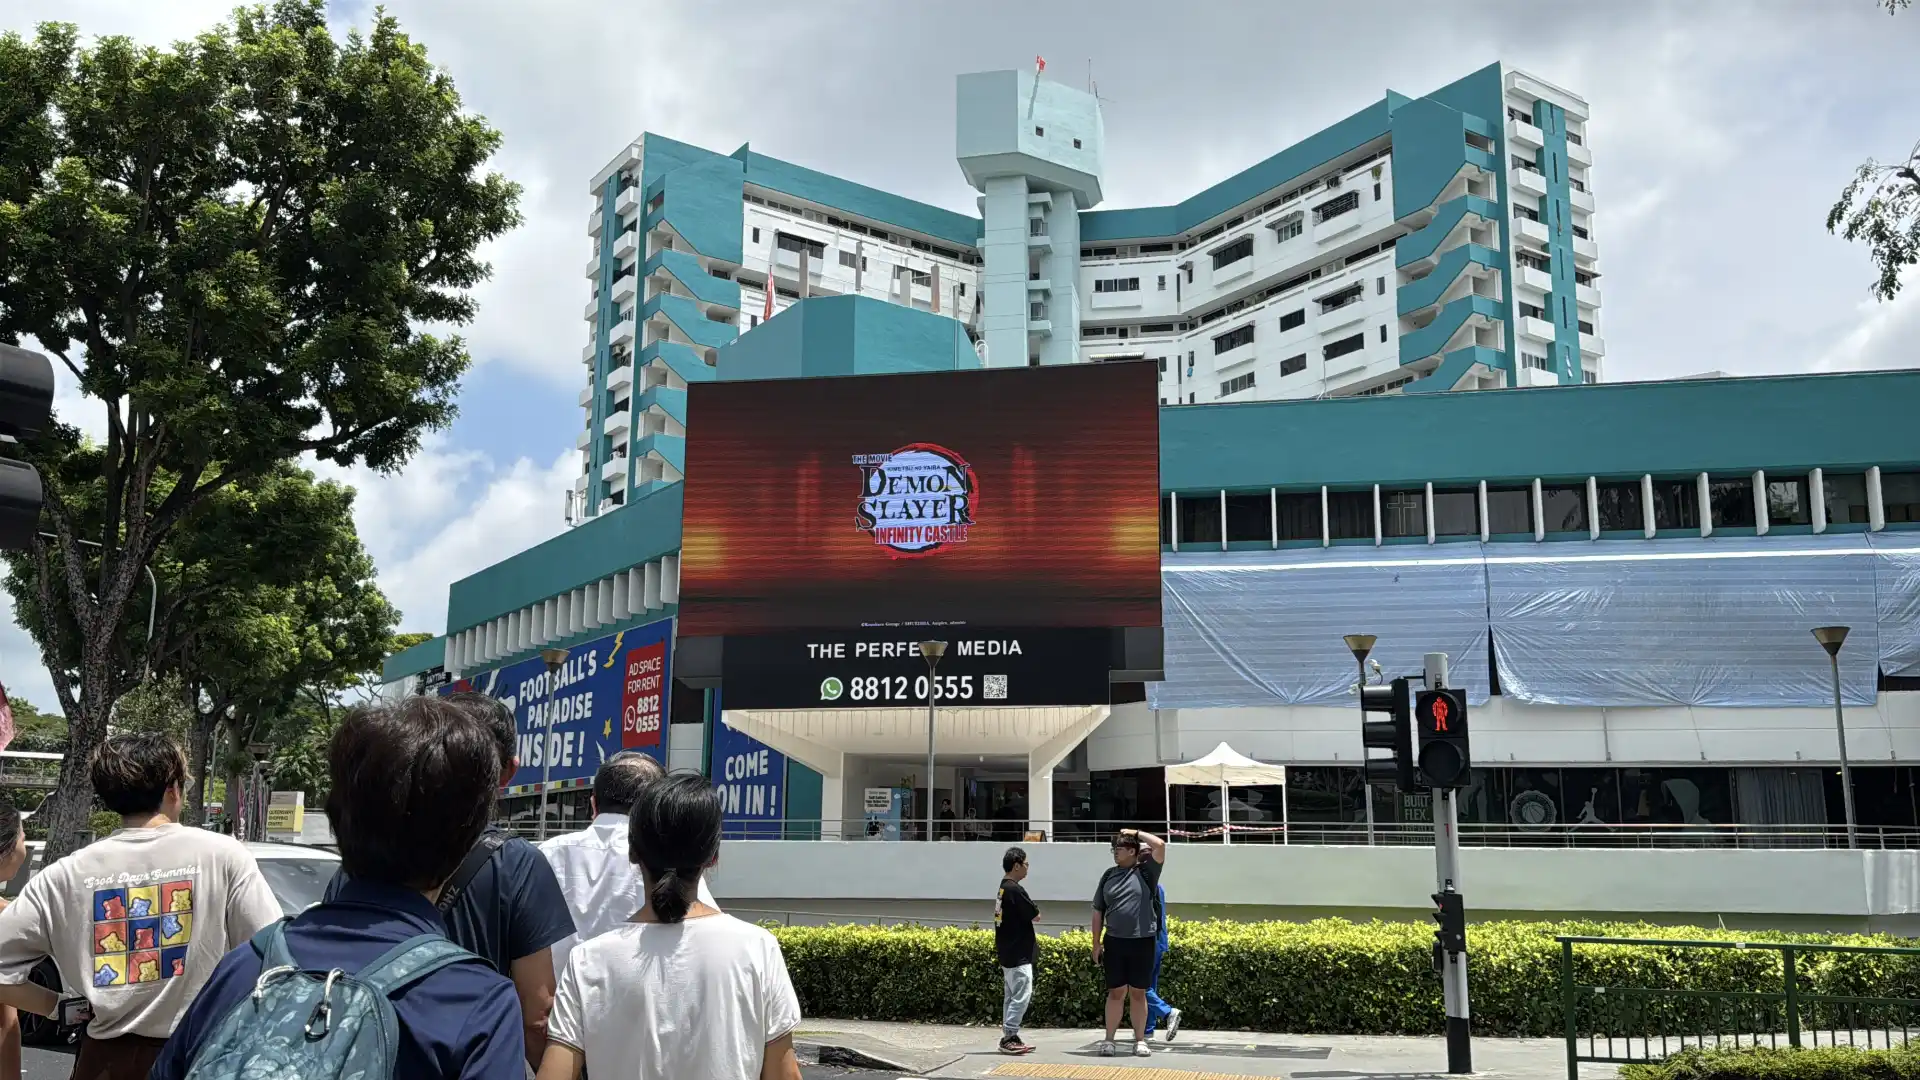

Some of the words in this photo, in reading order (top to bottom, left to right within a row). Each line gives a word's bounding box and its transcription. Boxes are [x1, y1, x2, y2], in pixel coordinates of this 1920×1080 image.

[853, 455, 867, 464] THE
[868, 454, 892, 463] MOVIE
[858, 464, 970, 498] DEMON
[855, 493, 976, 532] SLAYER
[875, 526, 922, 544] INFINITY
[924, 525, 967, 542] CASTLE
[807, 643, 846, 659] THE
[855, 641, 920, 657] PERFE
[957, 640, 1022, 656] MEDIA
[628, 663, 639, 676] AD
[639, 657, 661, 674] SPACE
[628, 679, 641, 695] FOR
[641, 675, 661, 691] RENT
[850, 676, 908, 700] 8812
[914, 675, 973, 699] 0555
[637, 694, 660, 714] 8812
[636, 713, 660, 733] 0555
[516, 731, 575, 767] INSDE
[725, 749, 769, 781] COME
[716, 784, 741, 814] ON
[745, 784, 765, 815] IN
[1404, 795, 1429, 807] BUILT
[84, 875, 114, 889] Good
[118, 871, 150, 884] Days
